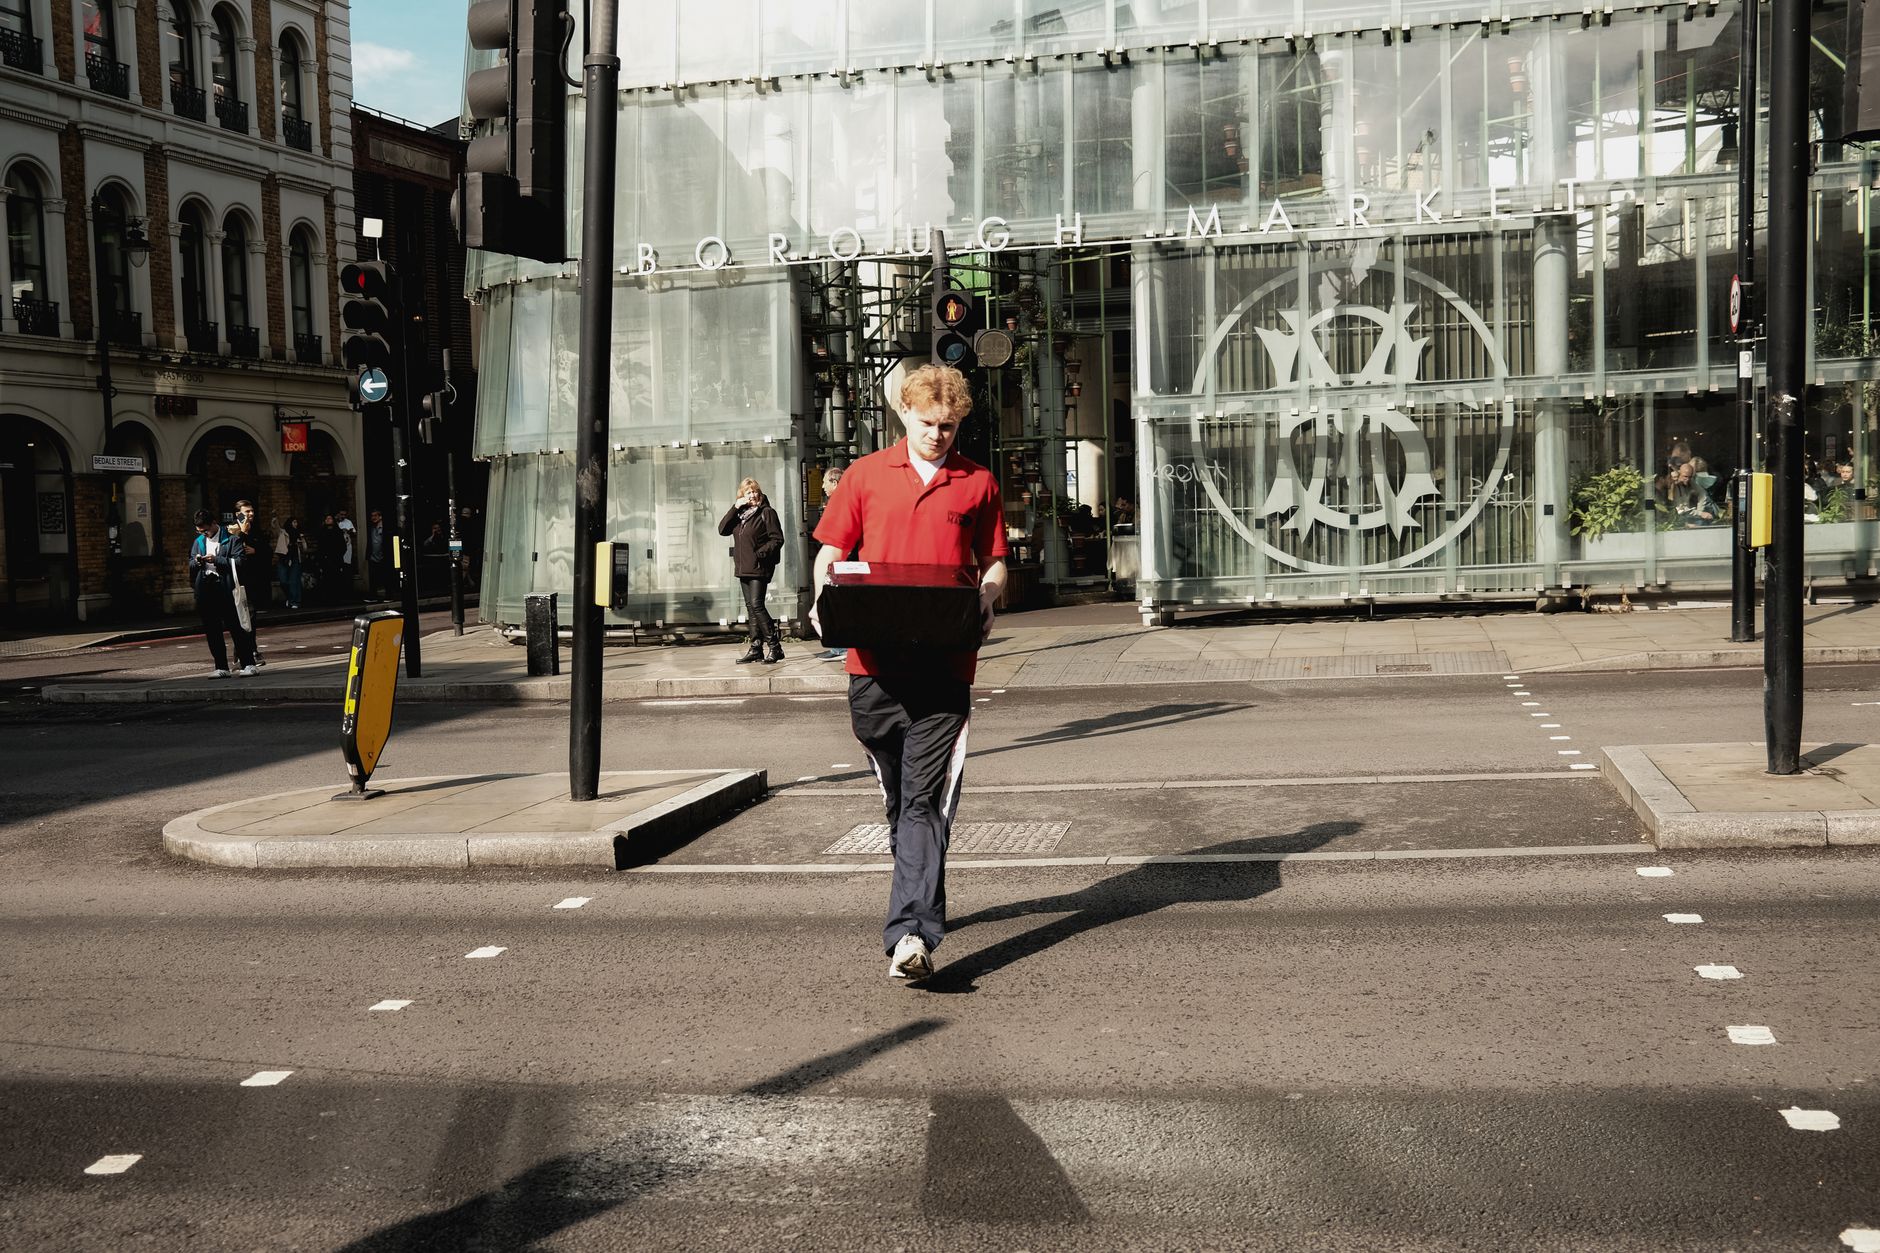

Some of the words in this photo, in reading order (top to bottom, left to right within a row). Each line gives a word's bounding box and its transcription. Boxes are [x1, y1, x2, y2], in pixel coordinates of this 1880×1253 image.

[637, 212, 1083, 275] BOROUGH
[1186, 178, 1584, 239] MARKET
[1732, 291, 1738, 315] 20
[183, 372, 205, 383] FOOD
[285, 443, 305, 451] LEON
[94, 456, 116, 465] BEDALE
[117, 458, 137, 466] STREET
